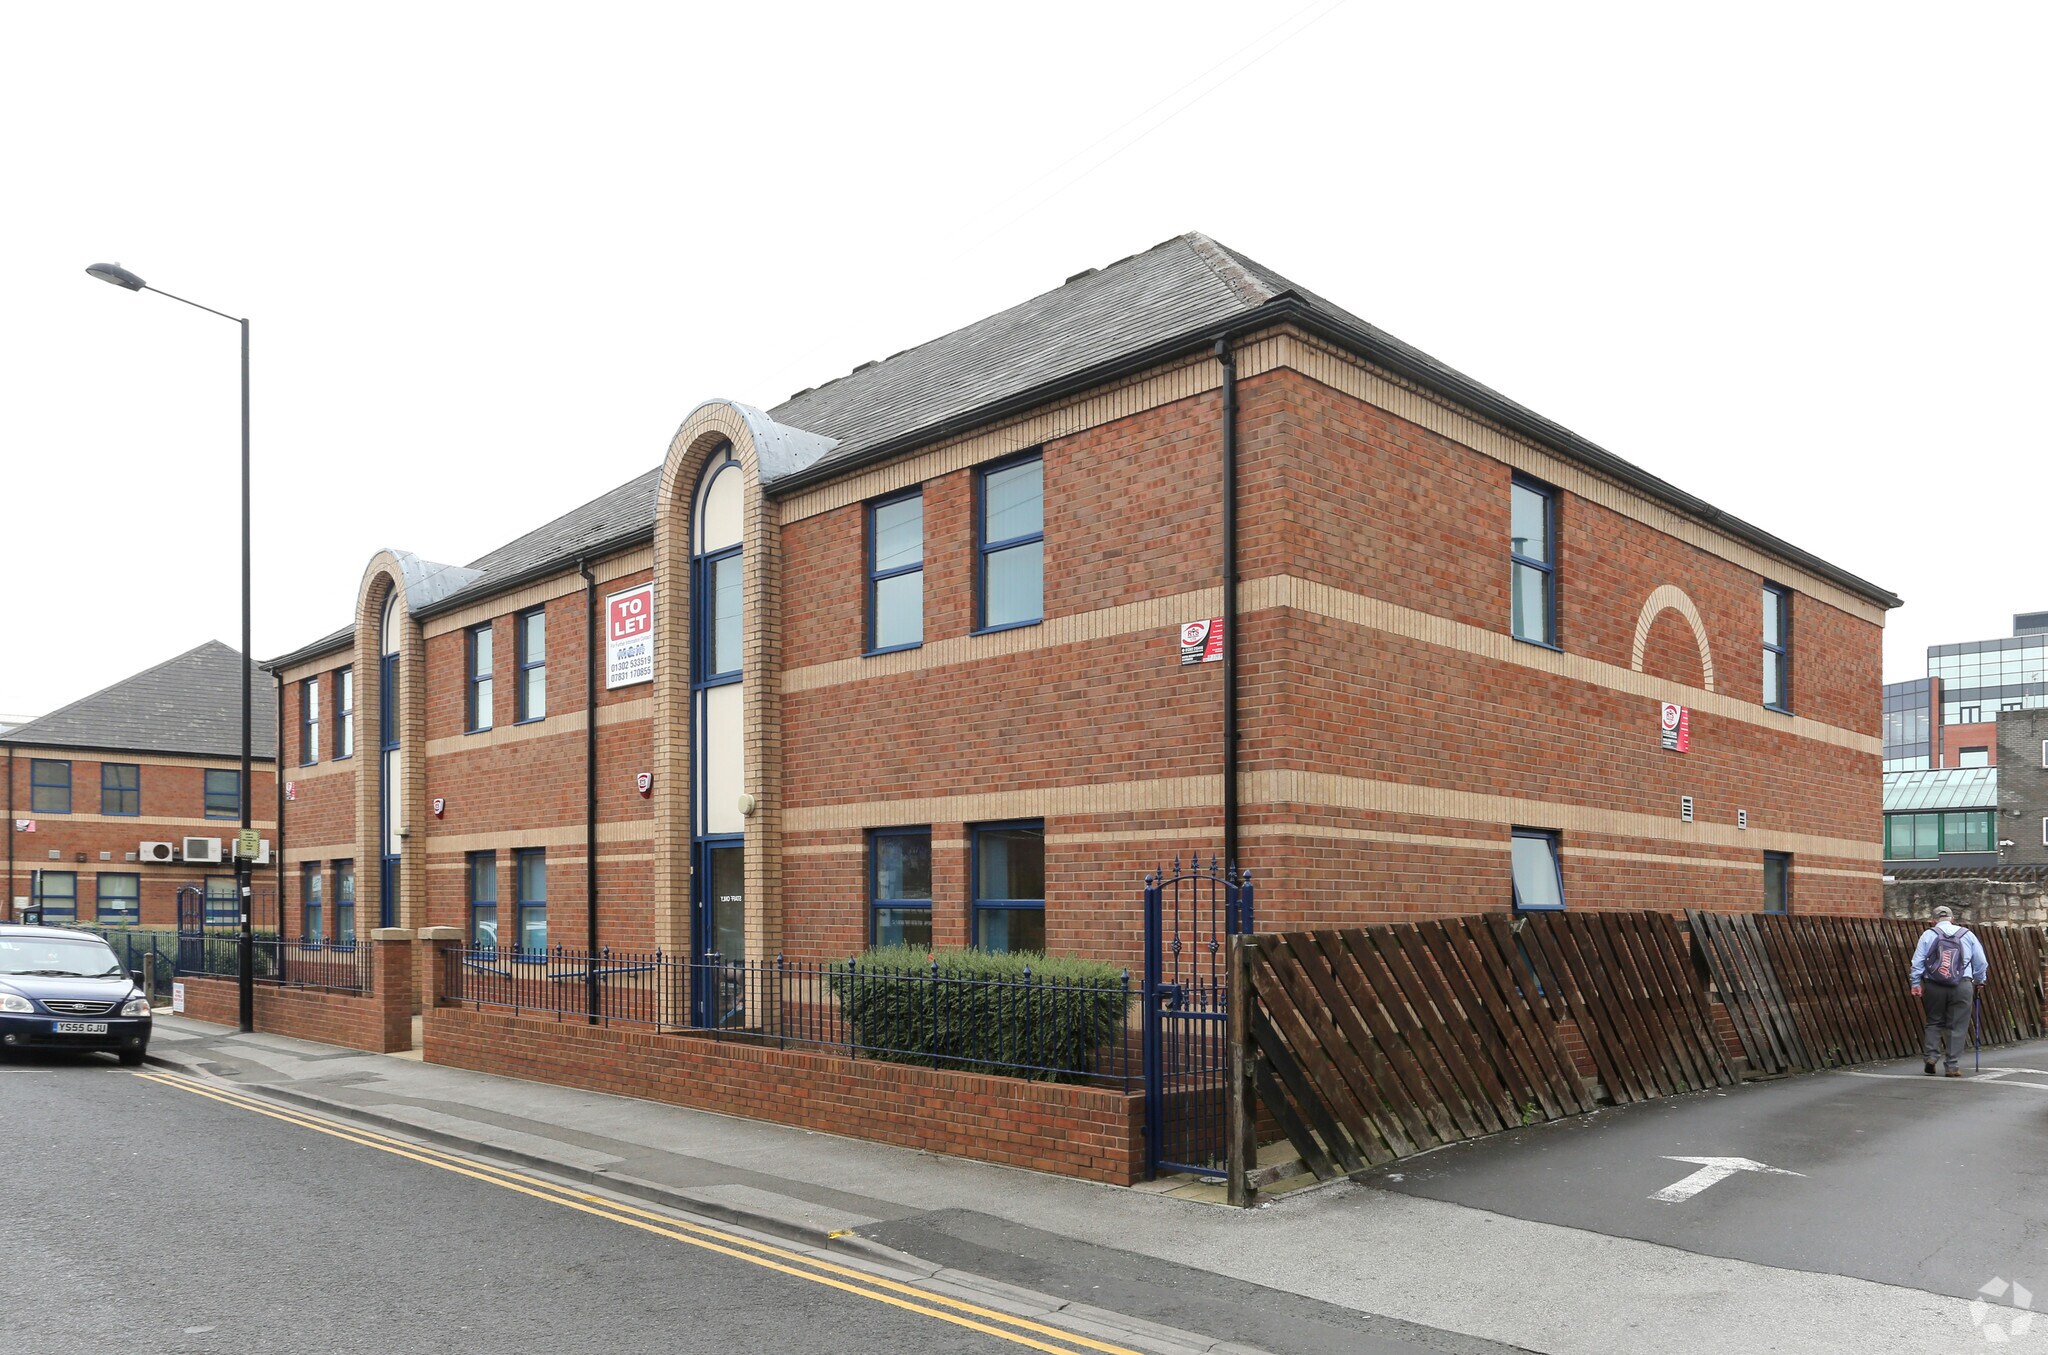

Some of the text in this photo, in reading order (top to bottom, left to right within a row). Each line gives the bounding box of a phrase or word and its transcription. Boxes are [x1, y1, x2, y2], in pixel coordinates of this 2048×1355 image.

[618, 598, 642, 618] TO
[614, 613, 647, 637] LET
[610, 655, 651, 673] 01302 533519
[610, 666, 651, 683] 07831 170855
[59, 1023, 85, 1032] YS55
[86, 1024, 107, 1033] GJU
